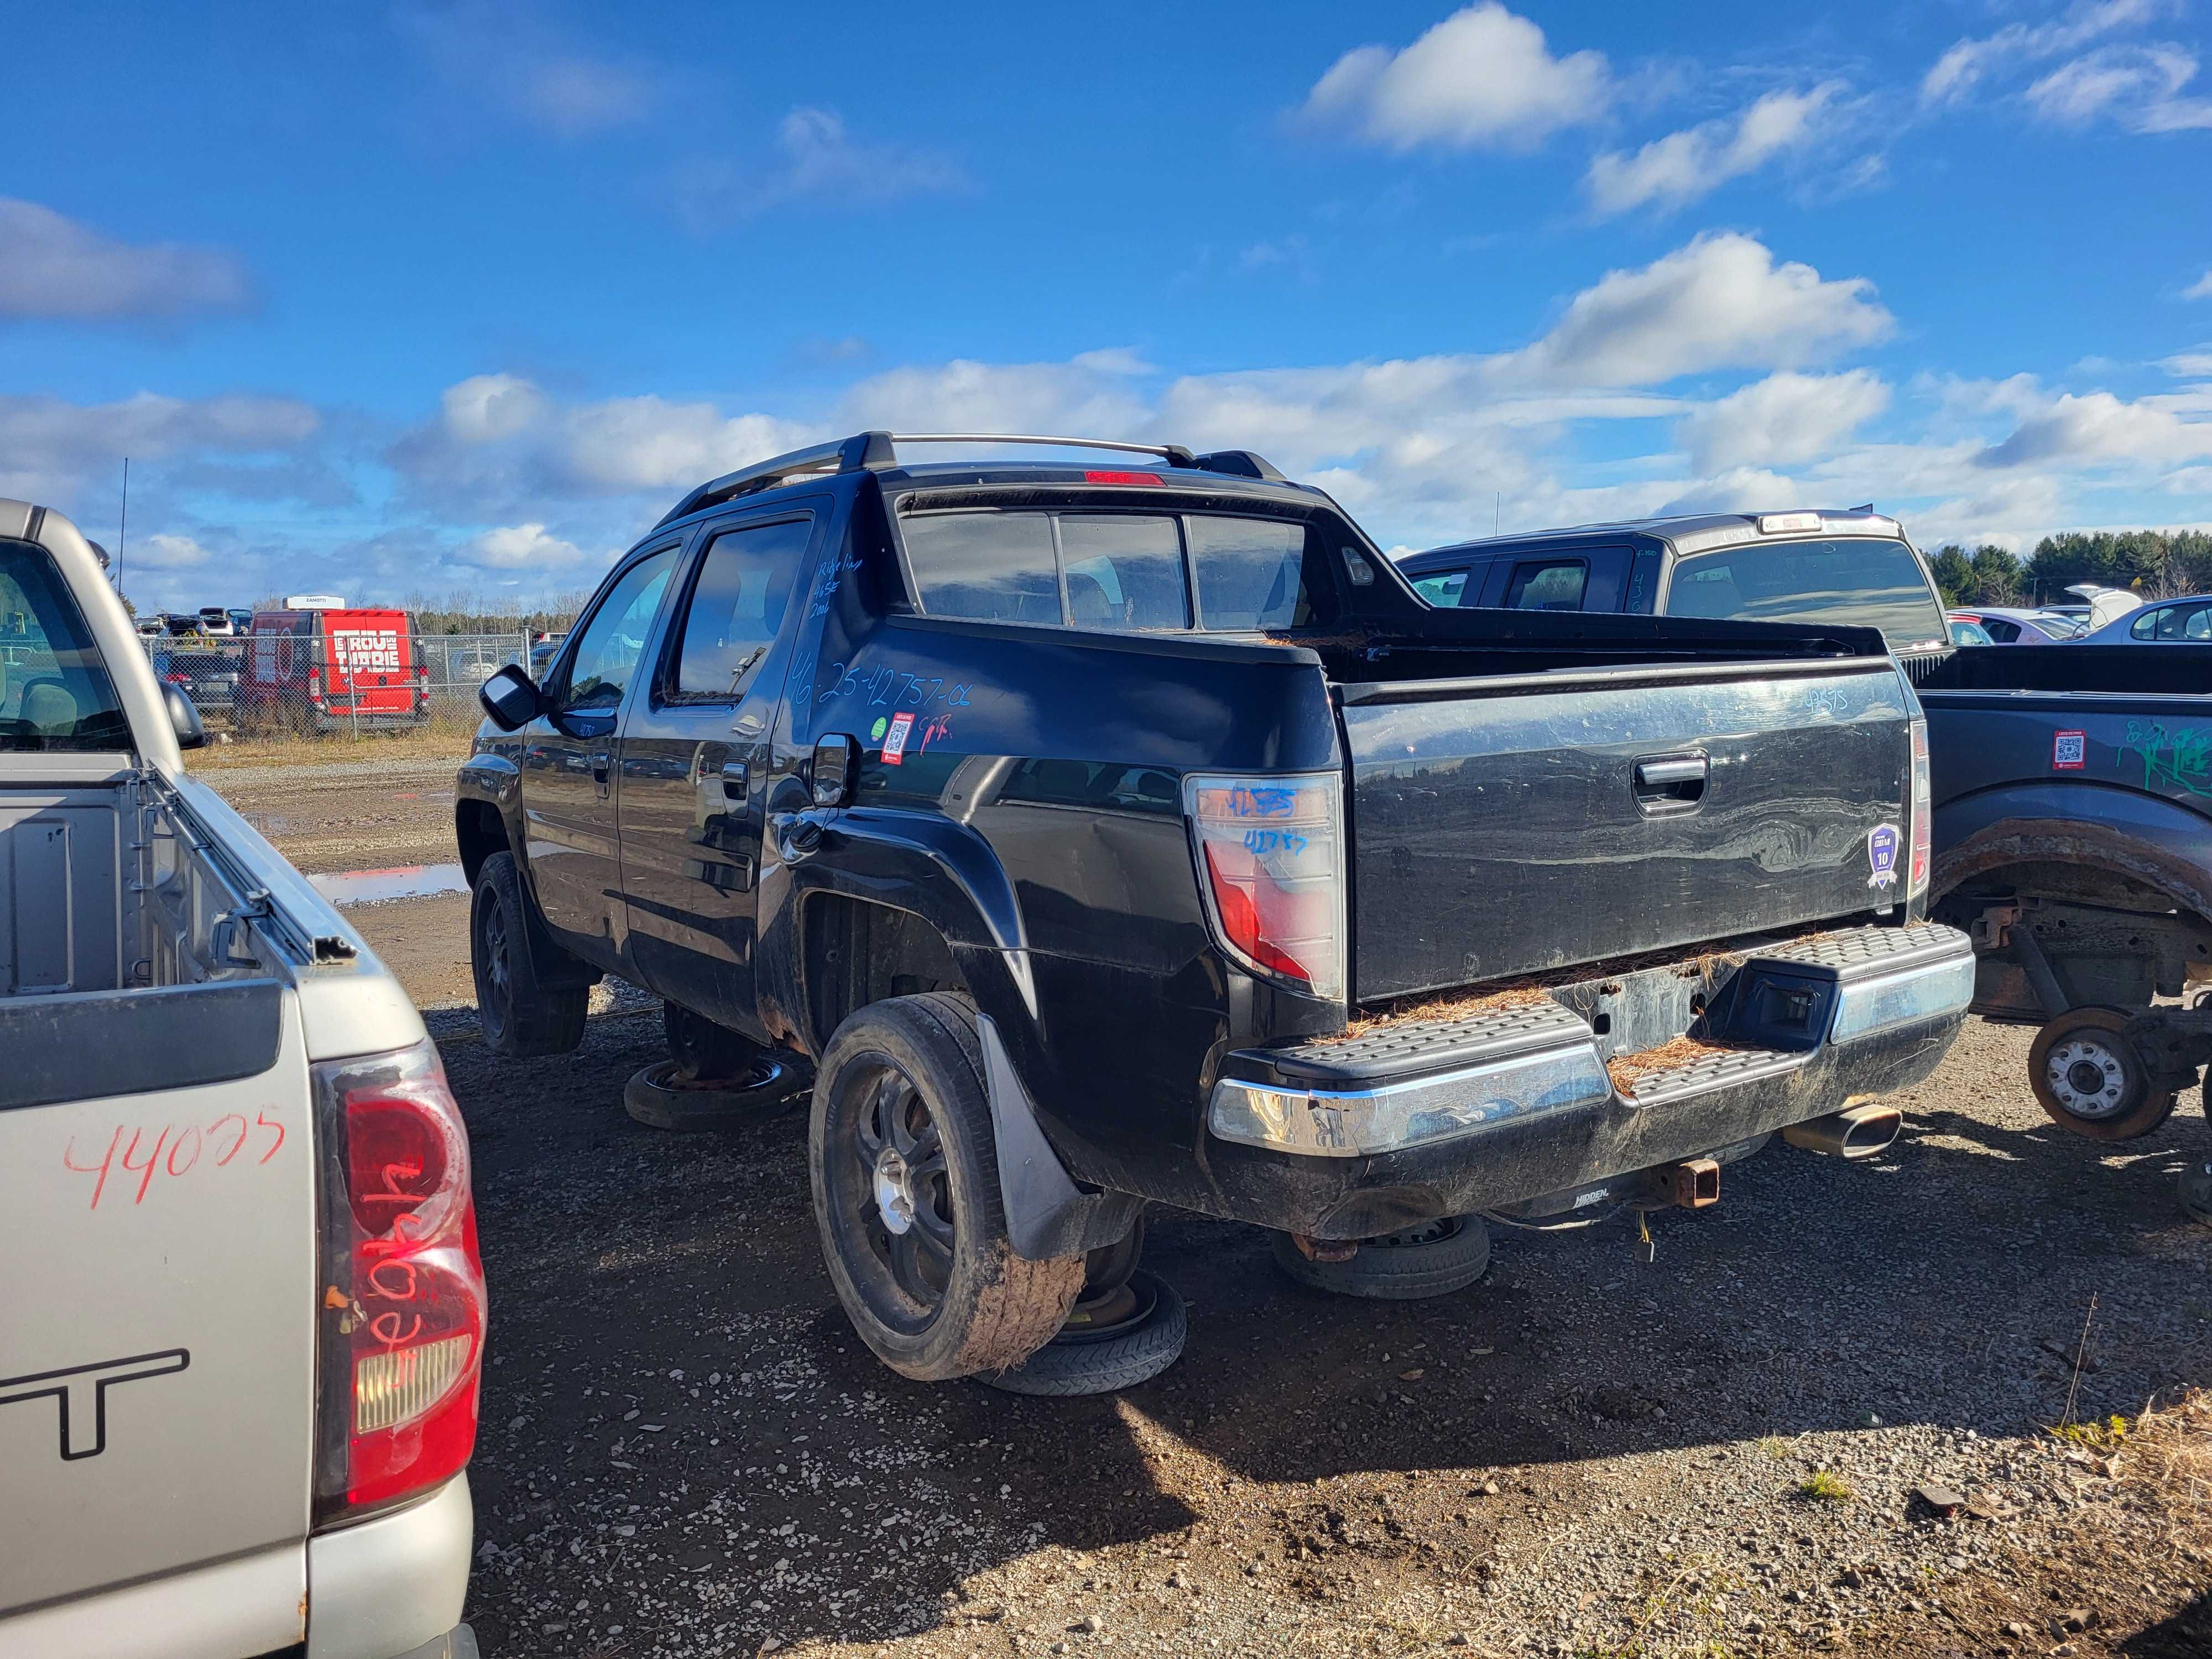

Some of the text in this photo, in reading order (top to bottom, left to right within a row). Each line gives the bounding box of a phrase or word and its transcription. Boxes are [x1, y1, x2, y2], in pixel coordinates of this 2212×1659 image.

[1877, 852, 1888, 866] 10
[64, 1110, 286, 1210] 44025
[1575, 1187, 1607, 1207] HIDDEN
